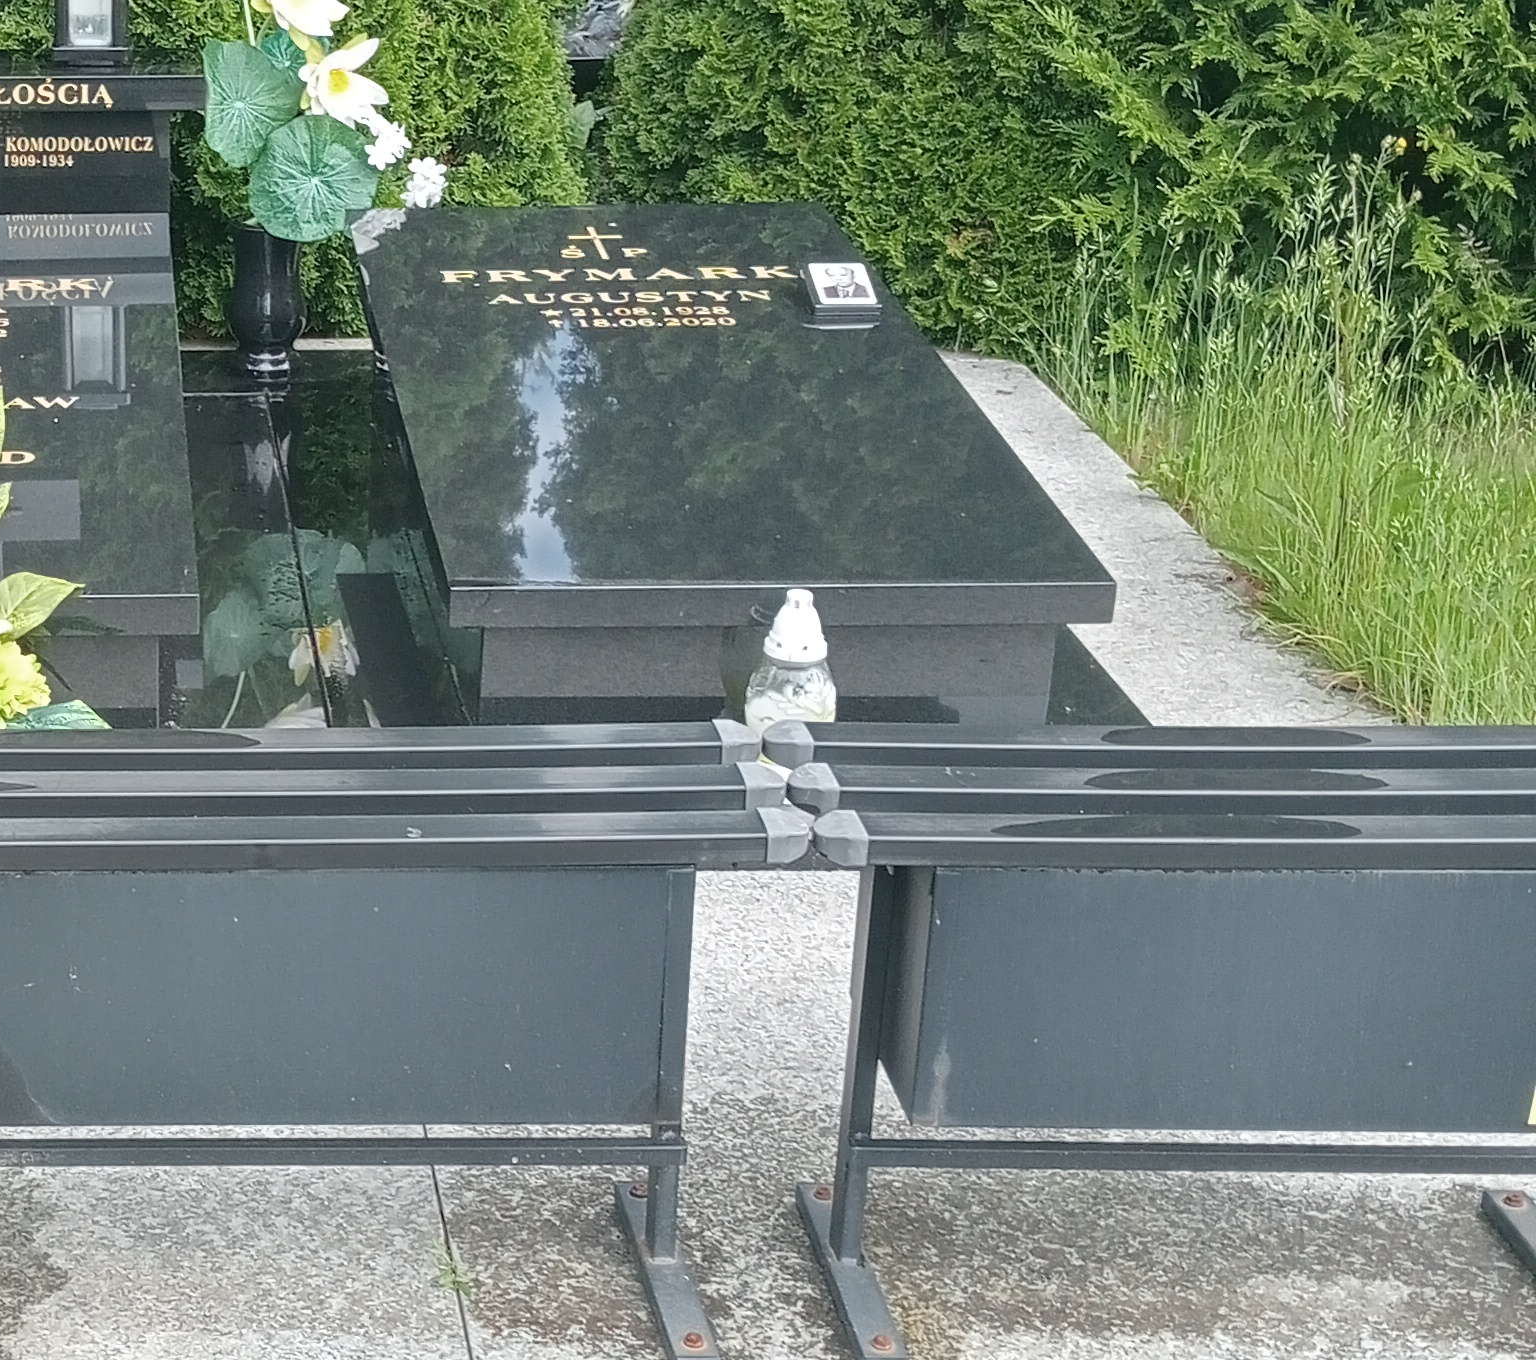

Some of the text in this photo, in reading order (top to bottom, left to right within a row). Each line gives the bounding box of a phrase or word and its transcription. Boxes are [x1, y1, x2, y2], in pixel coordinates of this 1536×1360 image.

[6, 137, 154, 152] KOMODOŁOWICZ
[560, 245, 648, 259] Ś P
[439, 266, 800, 284] FRYMARK
[488, 289, 772, 305] AUGUSTYN
[569, 306, 730, 317] 21.08.1928
[579, 317, 737, 328] 18.06.2020
